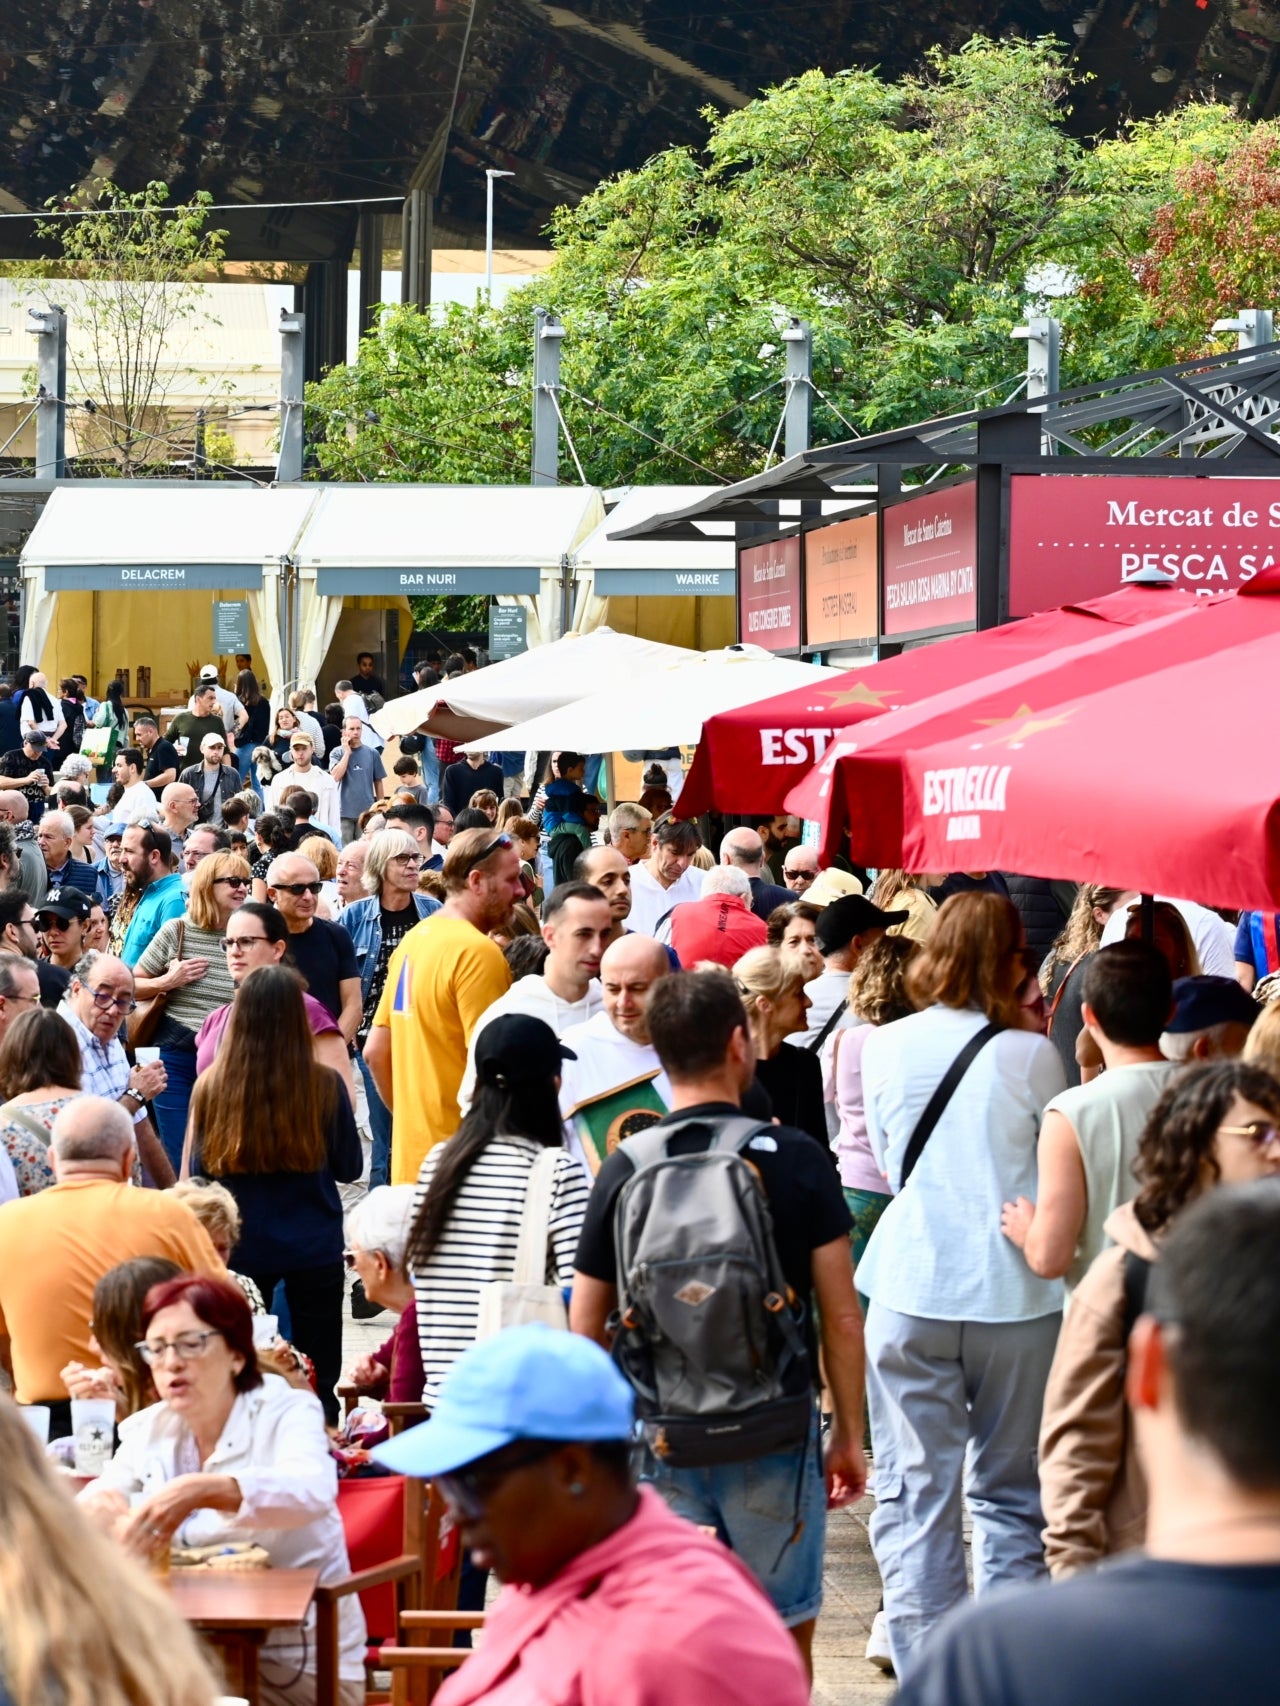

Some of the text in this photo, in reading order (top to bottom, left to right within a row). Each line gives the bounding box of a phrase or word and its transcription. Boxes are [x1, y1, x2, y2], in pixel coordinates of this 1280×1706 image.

[1106, 500, 1213, 527] Mercat
[1222, 502, 1259, 528] de
[121, 569, 185, 580] DELACREM
[400, 573, 456, 585] BAR NURI
[675, 573, 720, 585] WARIKE
[1121, 553, 1229, 581] PESCA
[886, 583, 900, 610] PESCA
[900, 578, 917, 607] SALADA
[917, 576, 931, 605] ROSA
[958, 566, 974, 595] CINTA
[759, 728, 842, 766] EST
[922, 765, 1012, 816] ESTRELLA
